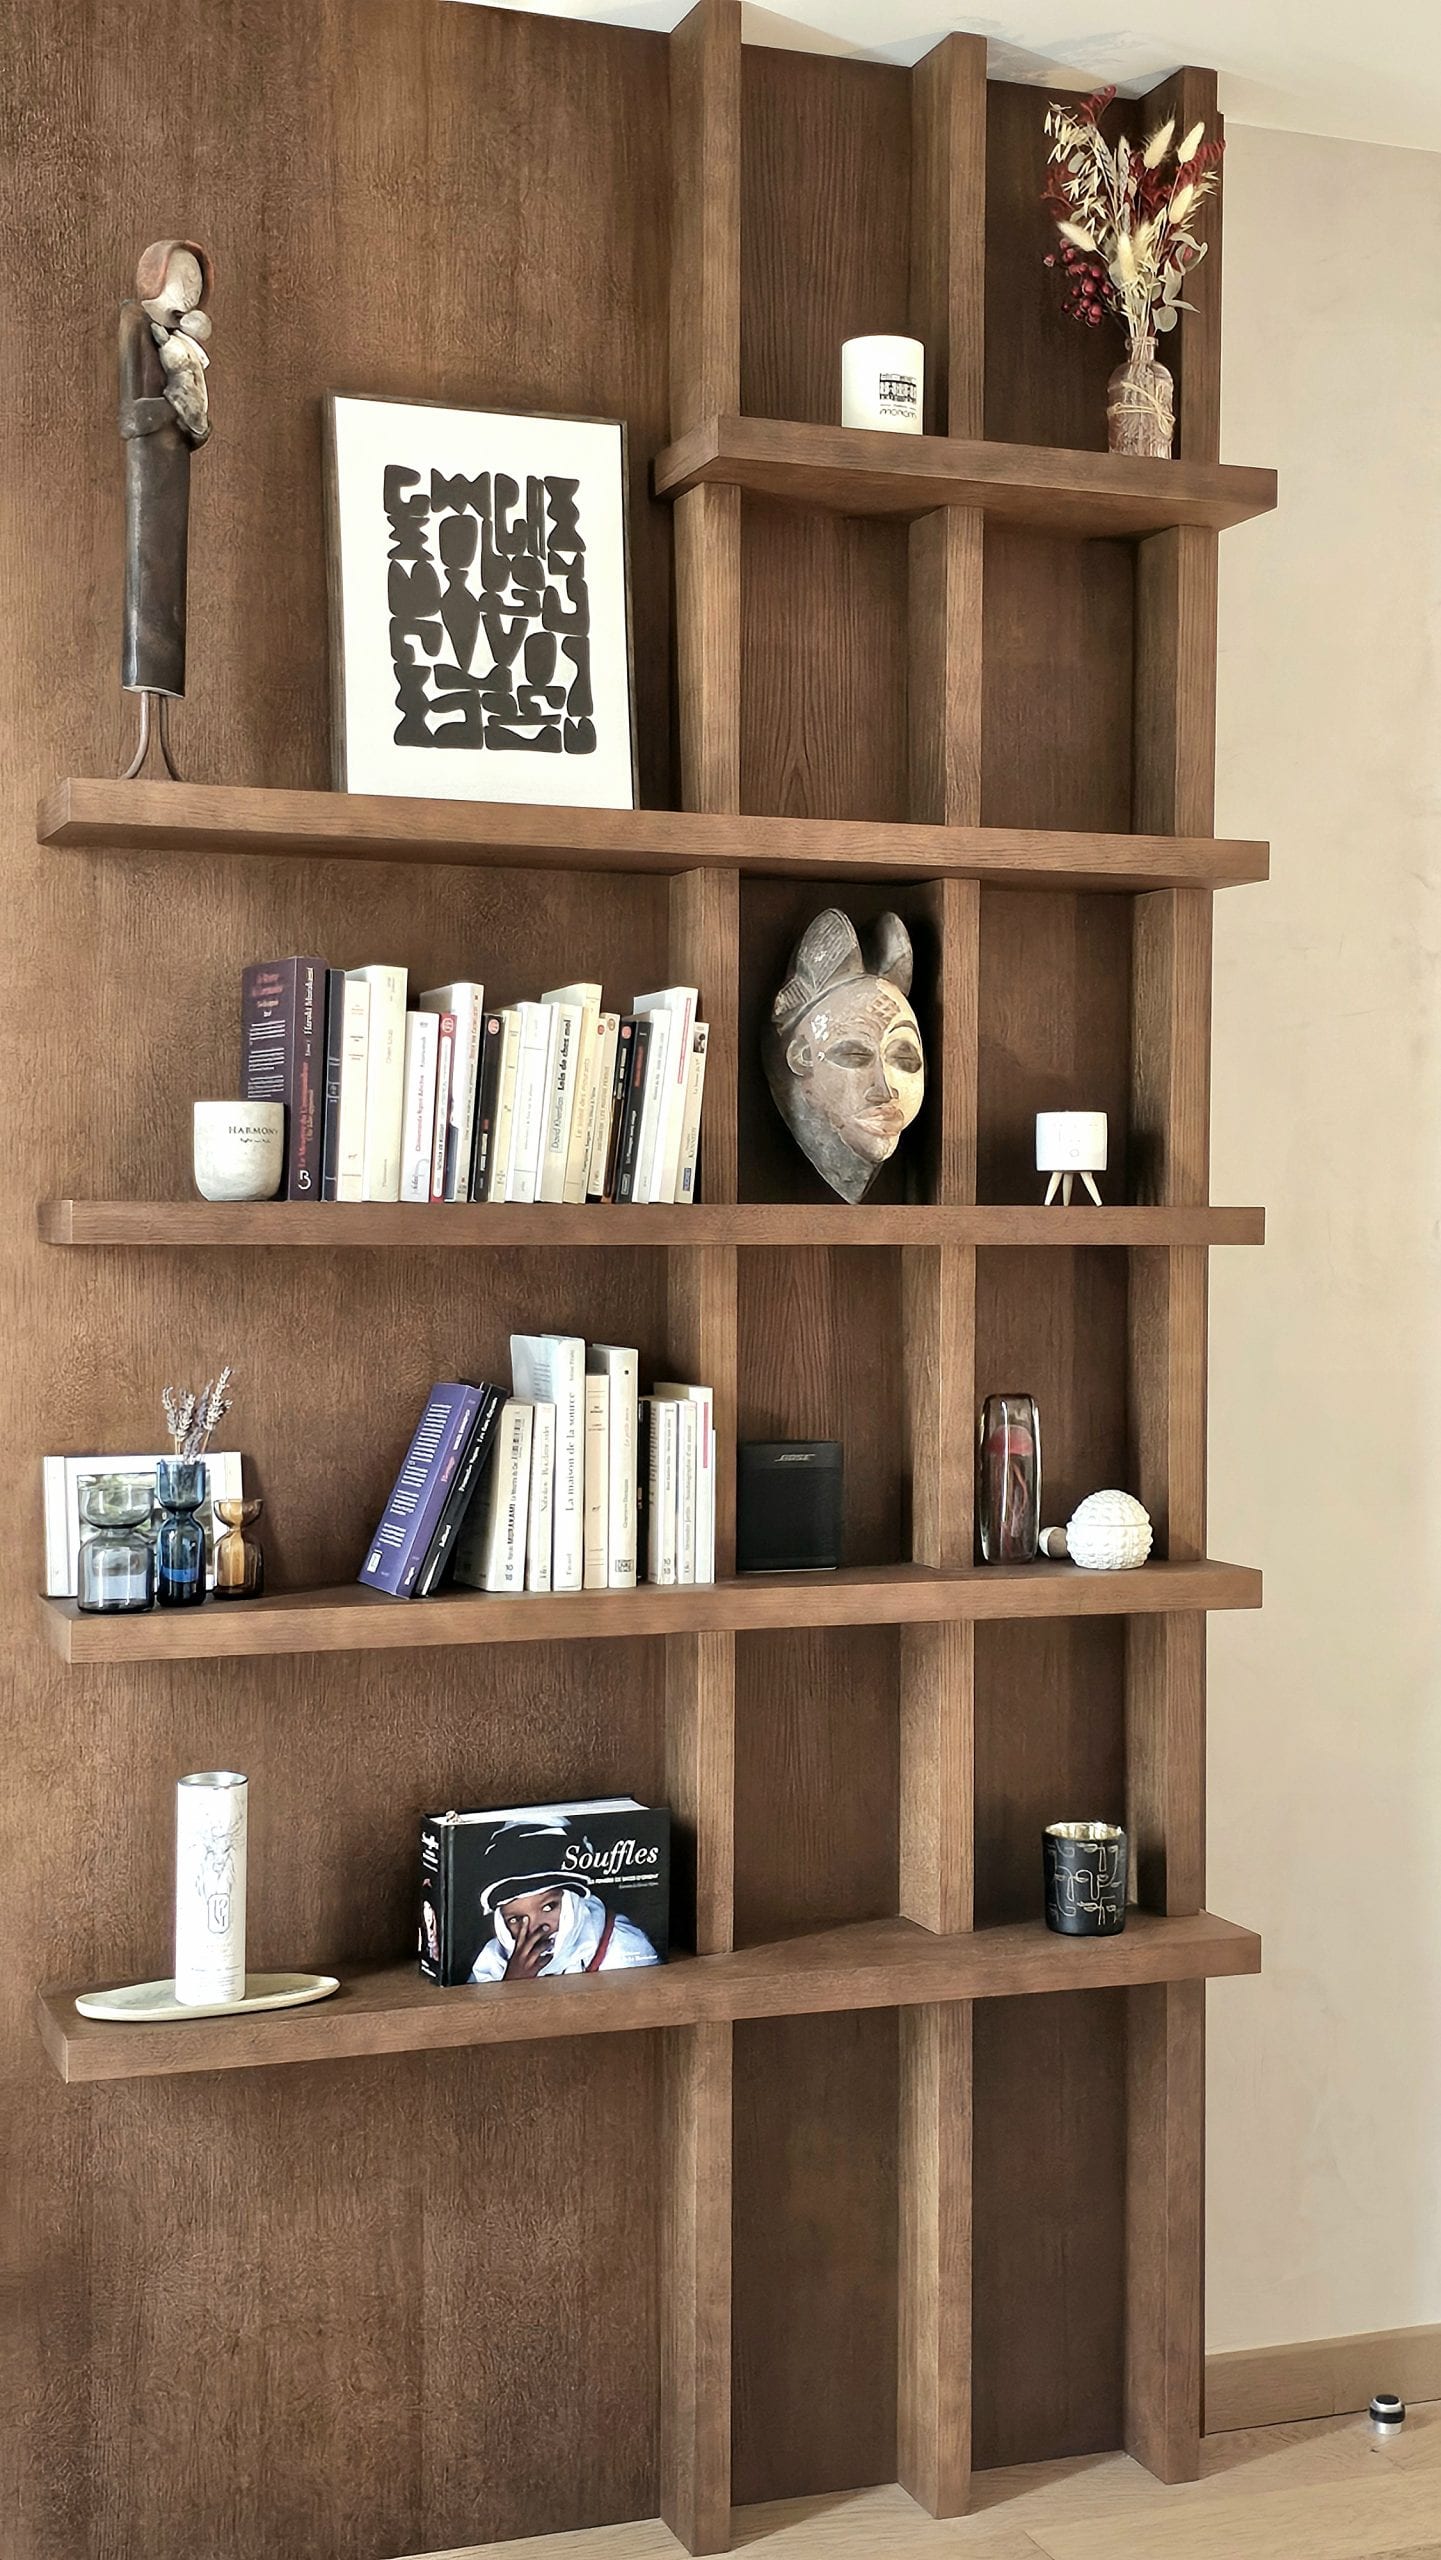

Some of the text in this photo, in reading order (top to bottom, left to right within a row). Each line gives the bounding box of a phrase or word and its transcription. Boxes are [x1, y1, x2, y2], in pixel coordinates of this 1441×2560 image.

[557, 1072, 565, 1091] Loin
[228, 1126, 279, 1135] HARMONY
[568, 1392, 576, 1426] source
[566, 1428, 575, 1438] la
[566, 1441, 575, 1455] de
[566, 1458, 575, 1495] maison
[565, 1498, 574, 1511] La
[560, 1838, 659, 1875] Souffles
